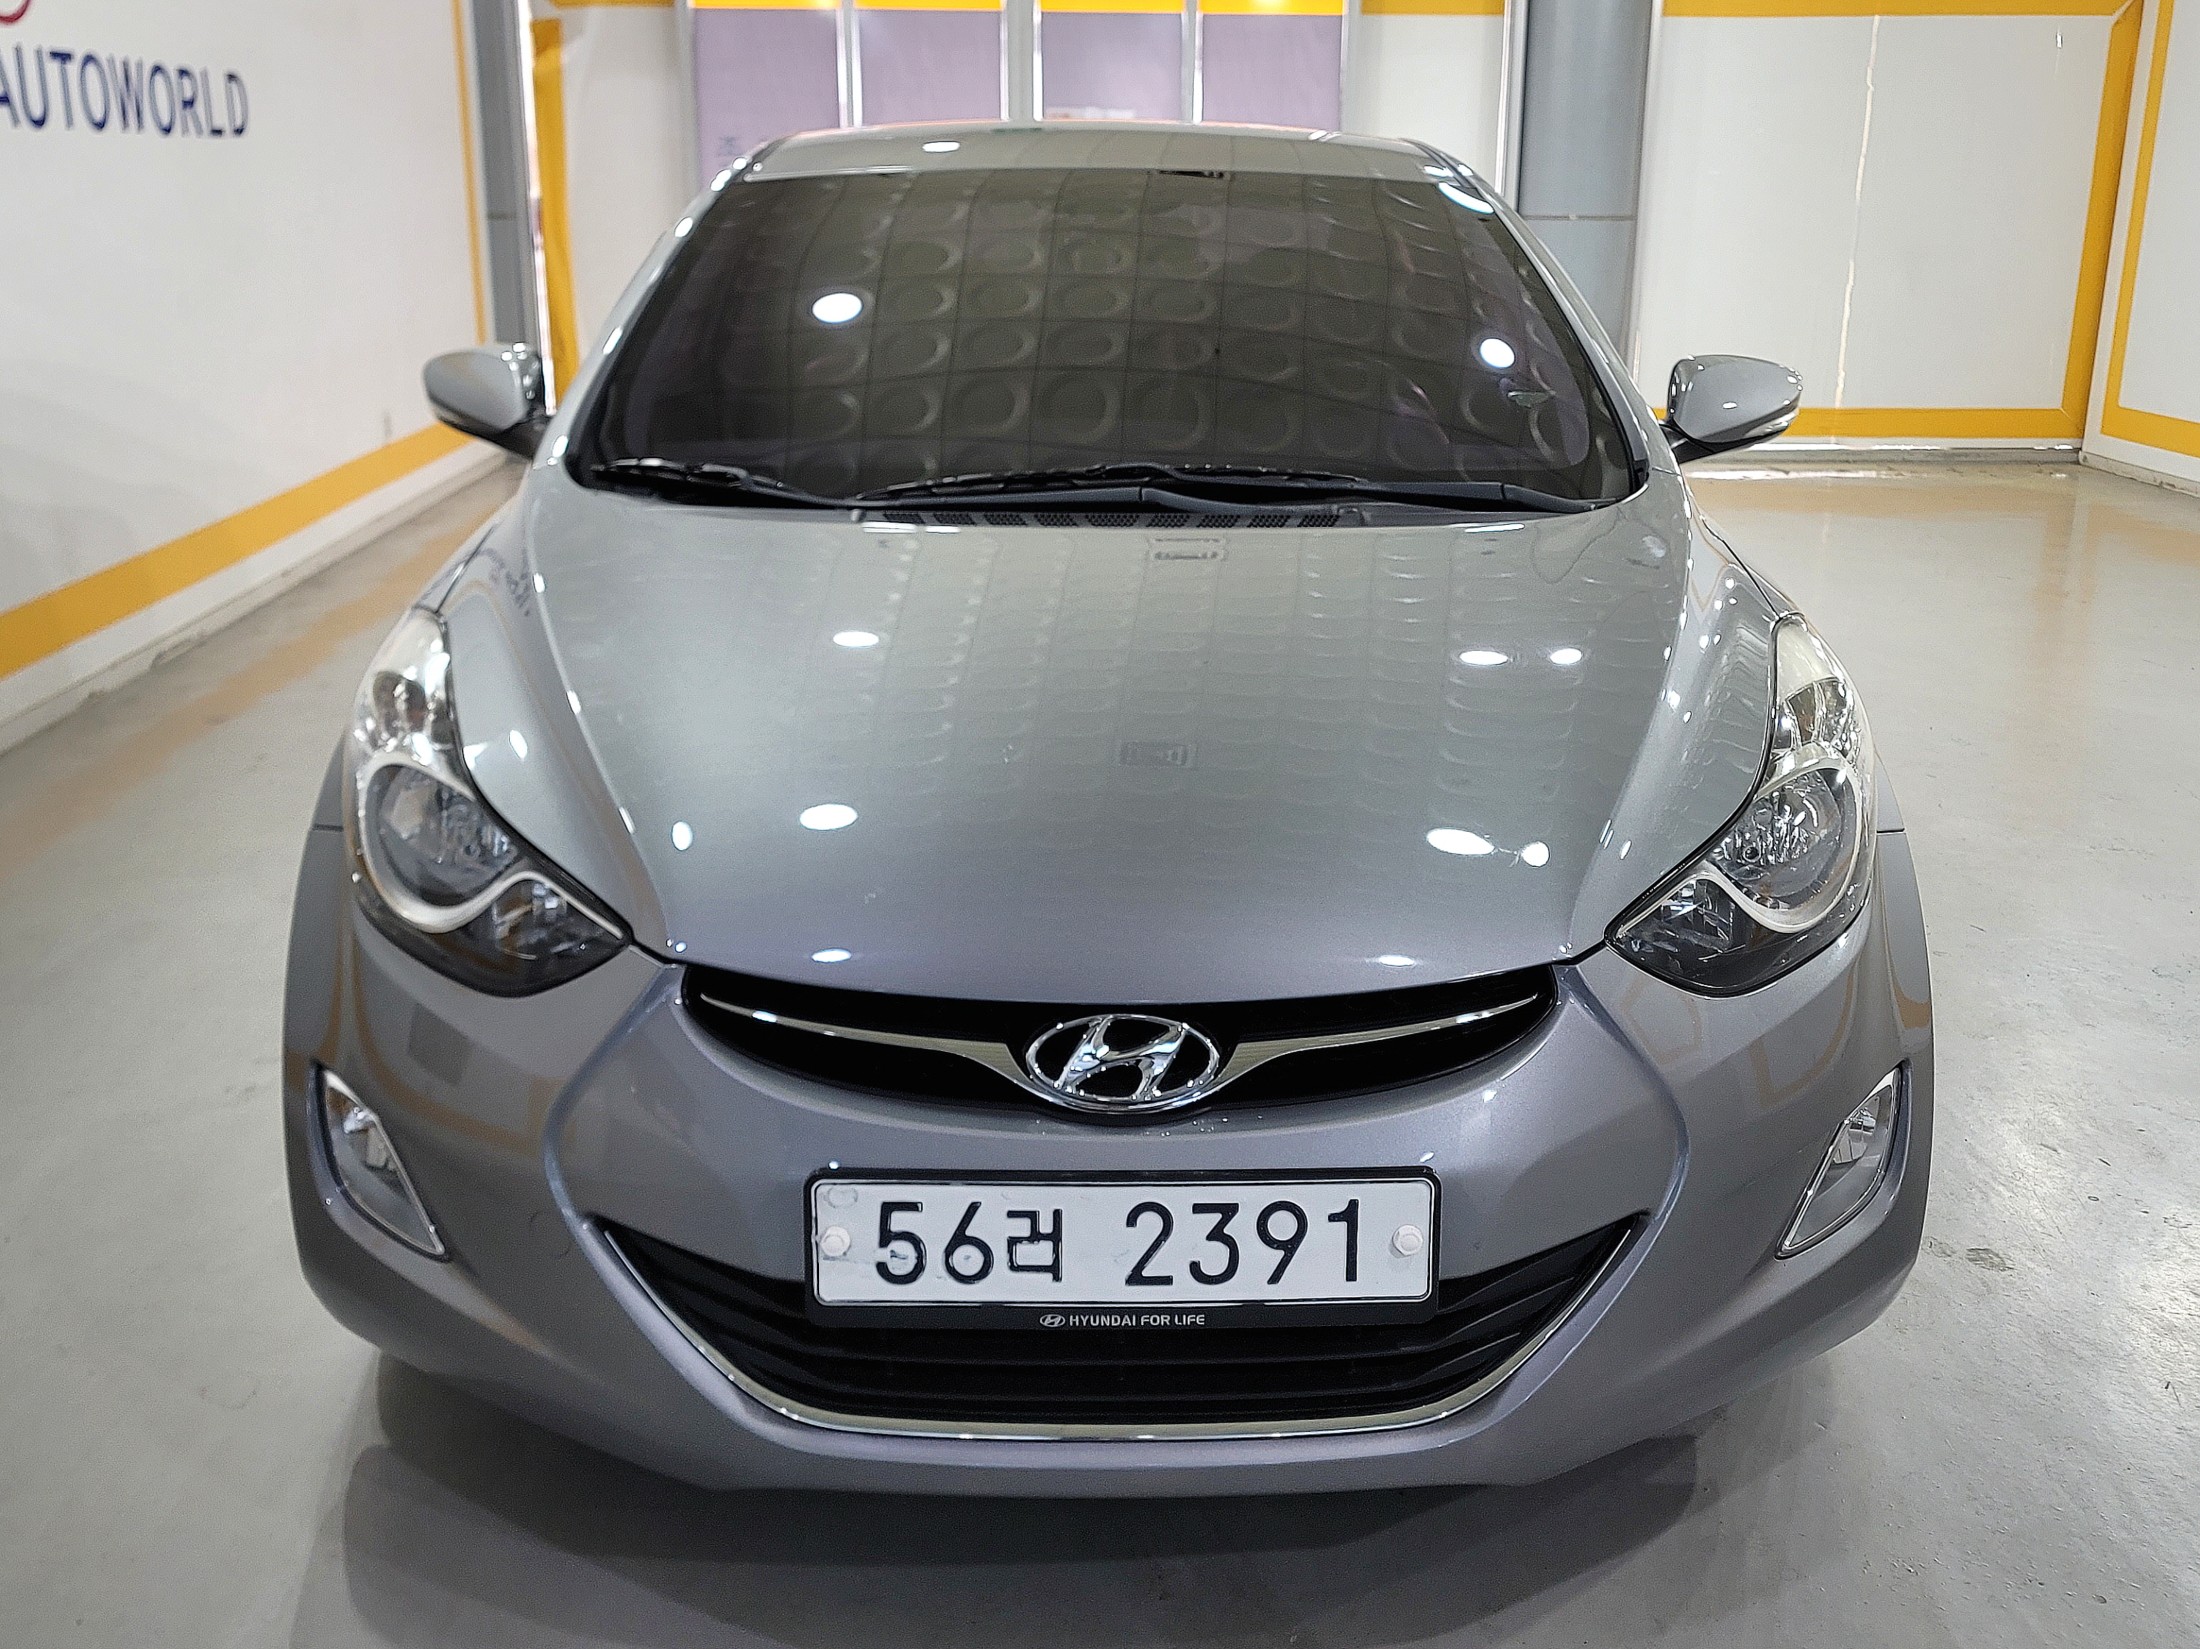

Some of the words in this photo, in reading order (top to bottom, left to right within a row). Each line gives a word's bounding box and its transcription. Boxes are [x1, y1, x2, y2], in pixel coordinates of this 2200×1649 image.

[875, 1201, 1063, 1286] 56러
[1124, 1199, 1360, 1287] 2391
[1069, 1314, 1137, 1327] HYUNDAI
[1140, 1314, 1171, 1327] FOR
[1174, 1314, 1206, 1326] LIFE
